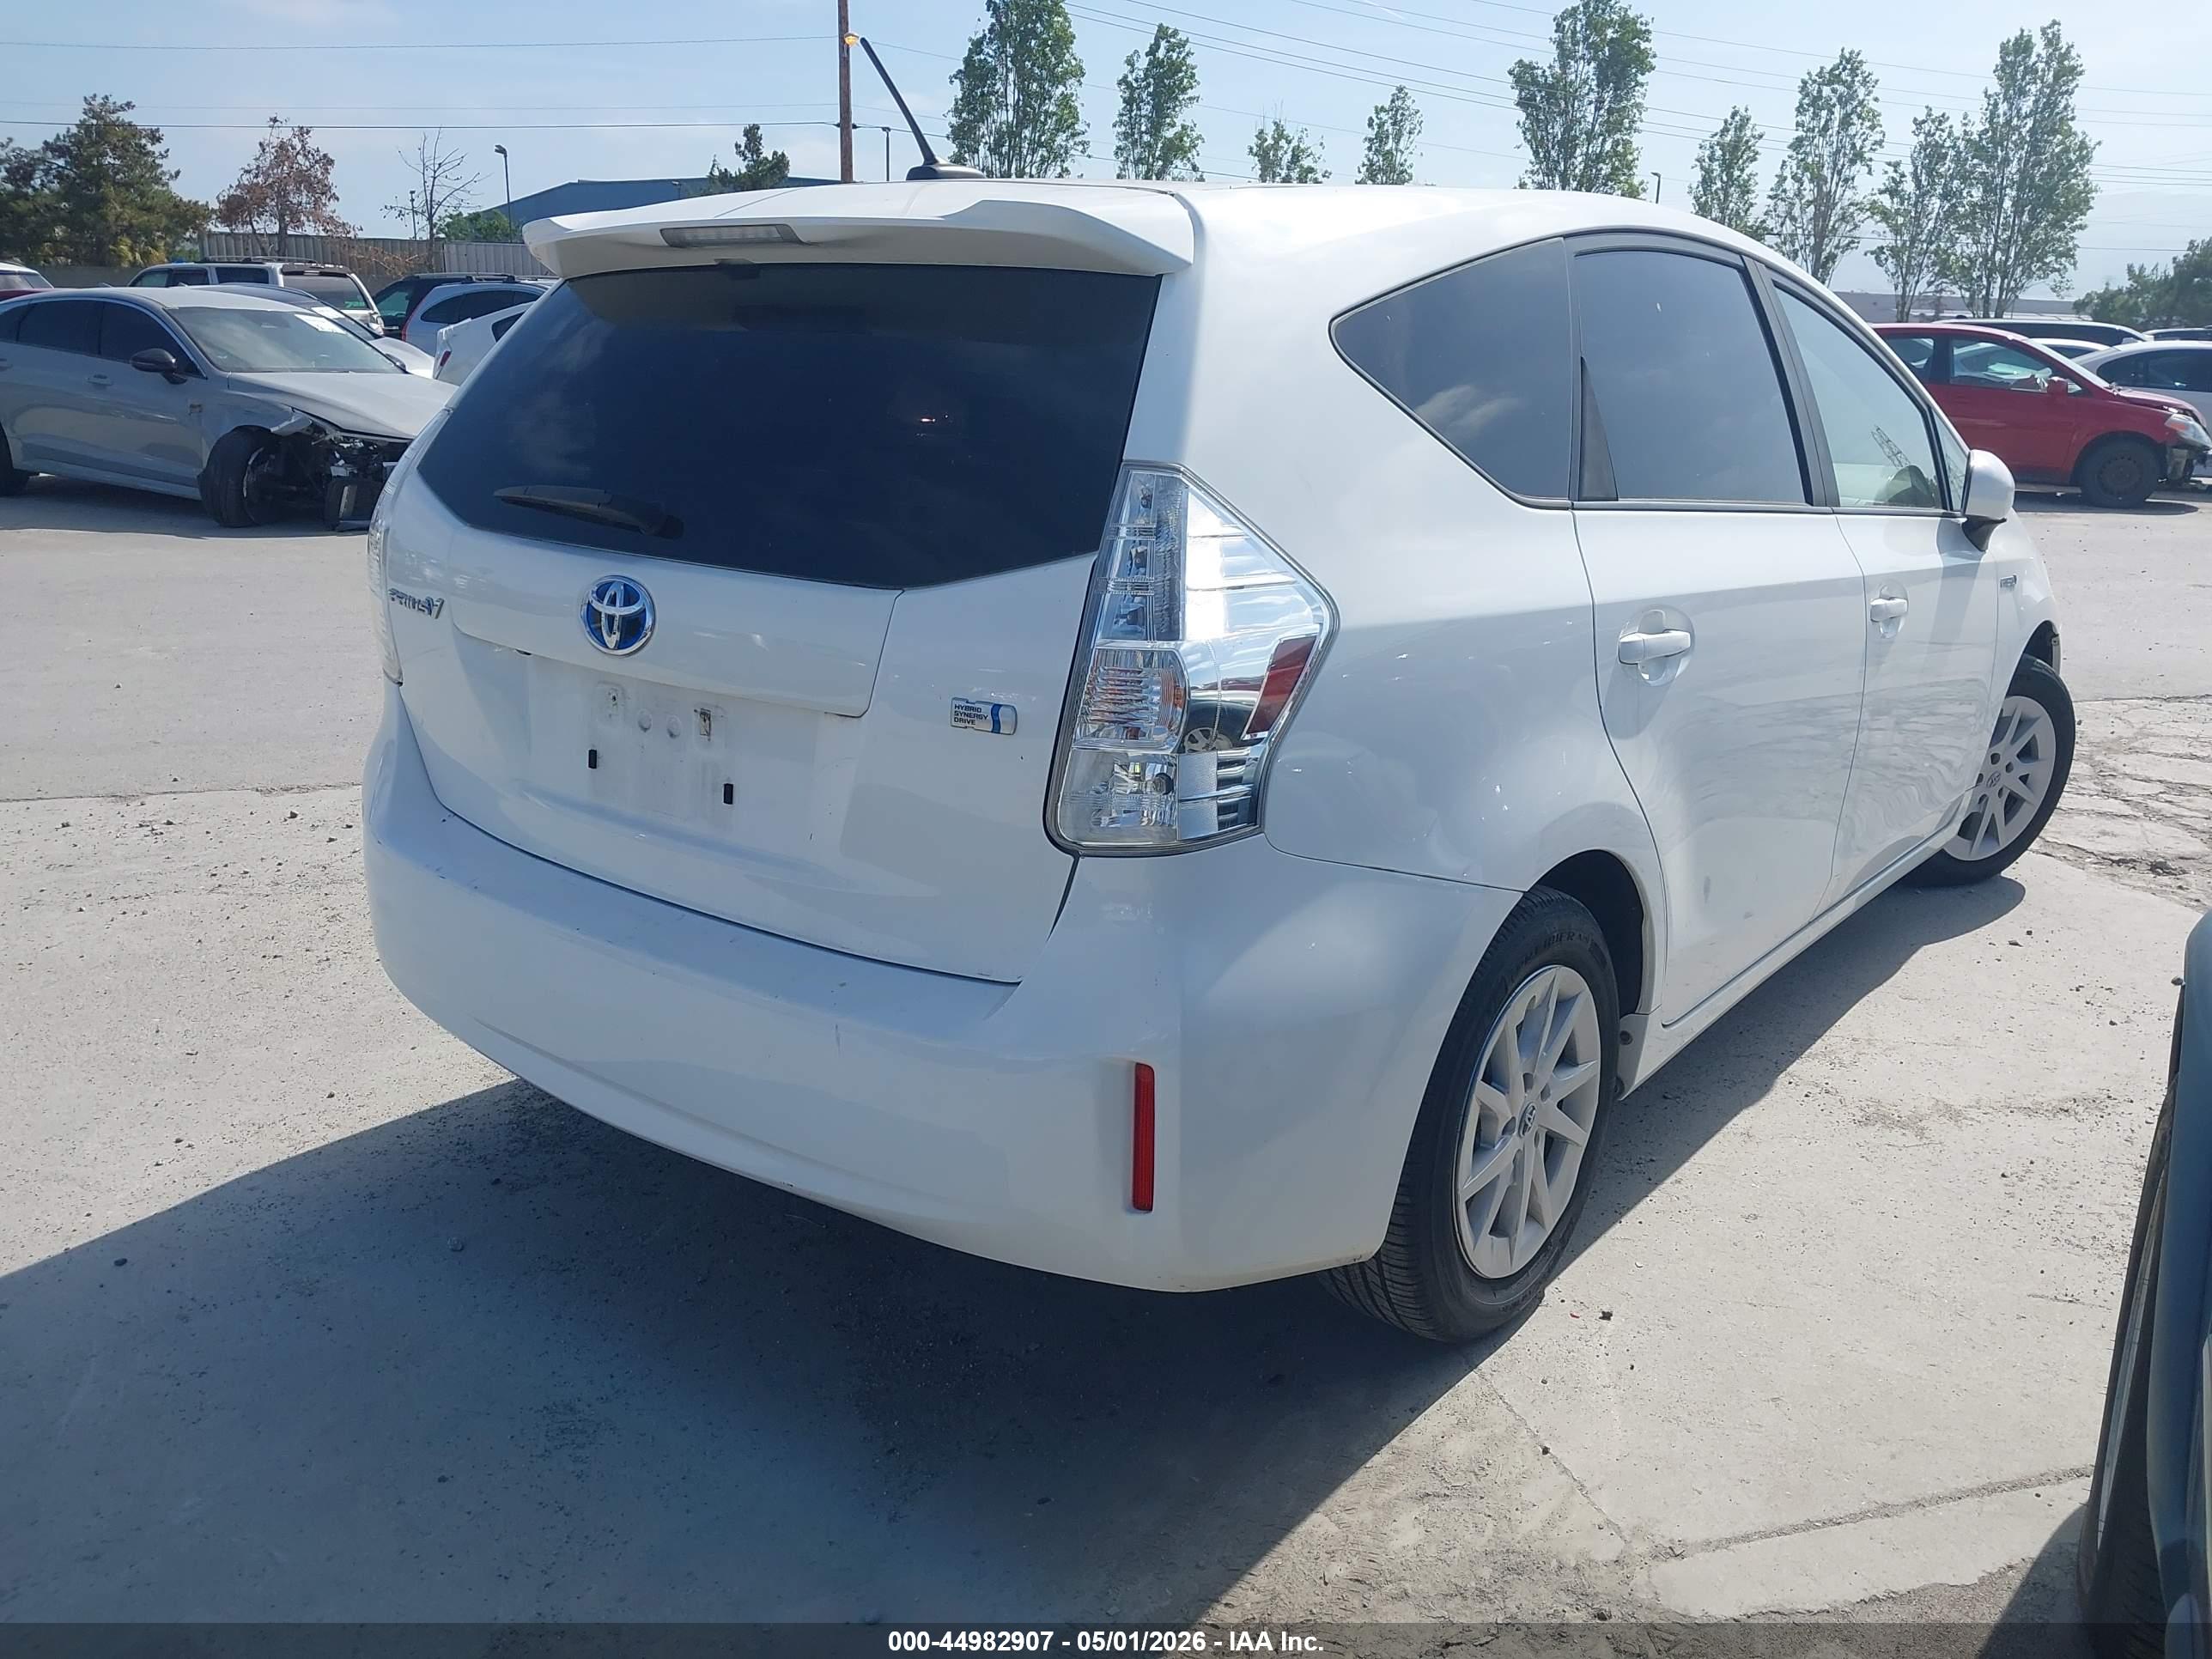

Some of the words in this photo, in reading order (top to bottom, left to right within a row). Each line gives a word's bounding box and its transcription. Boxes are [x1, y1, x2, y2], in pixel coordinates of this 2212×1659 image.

[954, 703, 982, 713] HYBRID
[953, 710, 988, 720] SYNERGY
[953, 717, 976, 726] DRIVE
